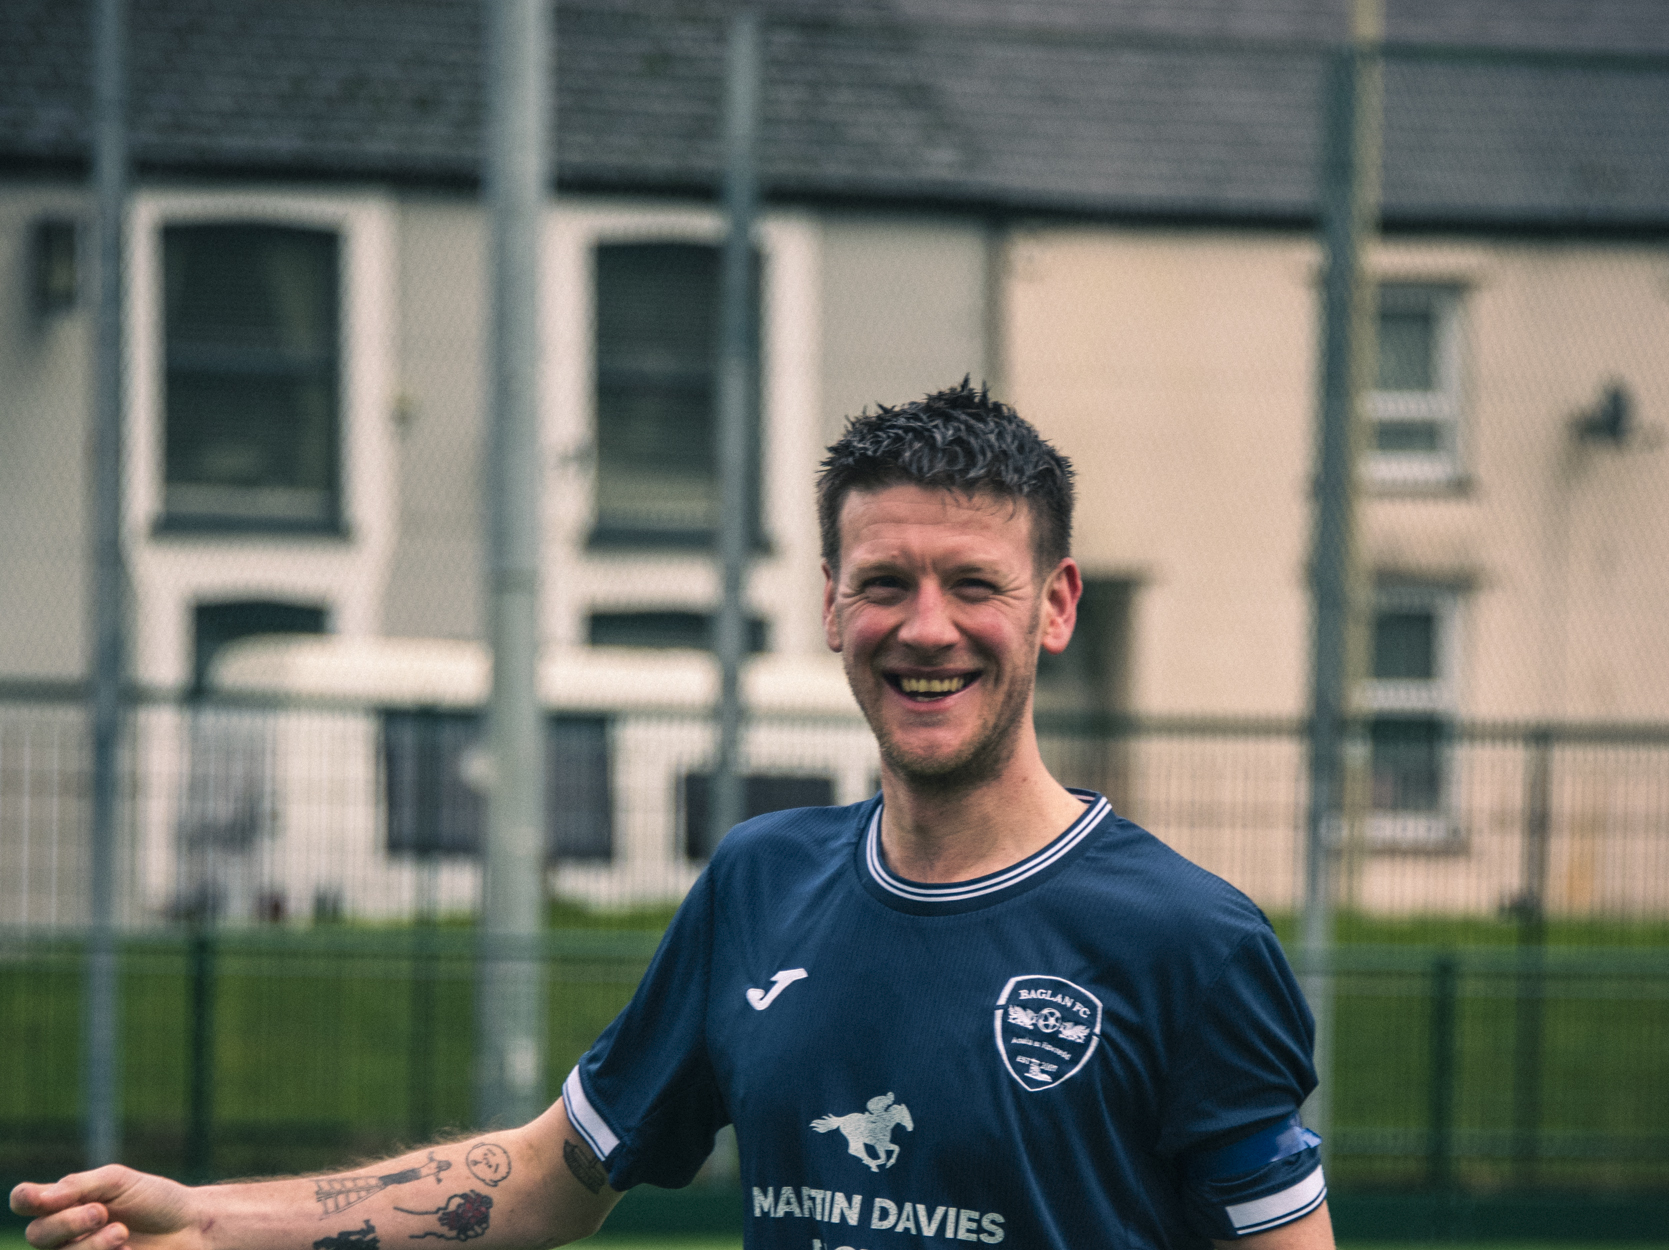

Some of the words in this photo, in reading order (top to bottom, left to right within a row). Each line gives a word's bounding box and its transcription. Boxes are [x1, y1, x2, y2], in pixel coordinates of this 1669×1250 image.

[1018, 989, 1074, 1007] BAGLAN
[1072, 1002, 1091, 1018] FC
[870, 1198, 1006, 1244] DAVIES
